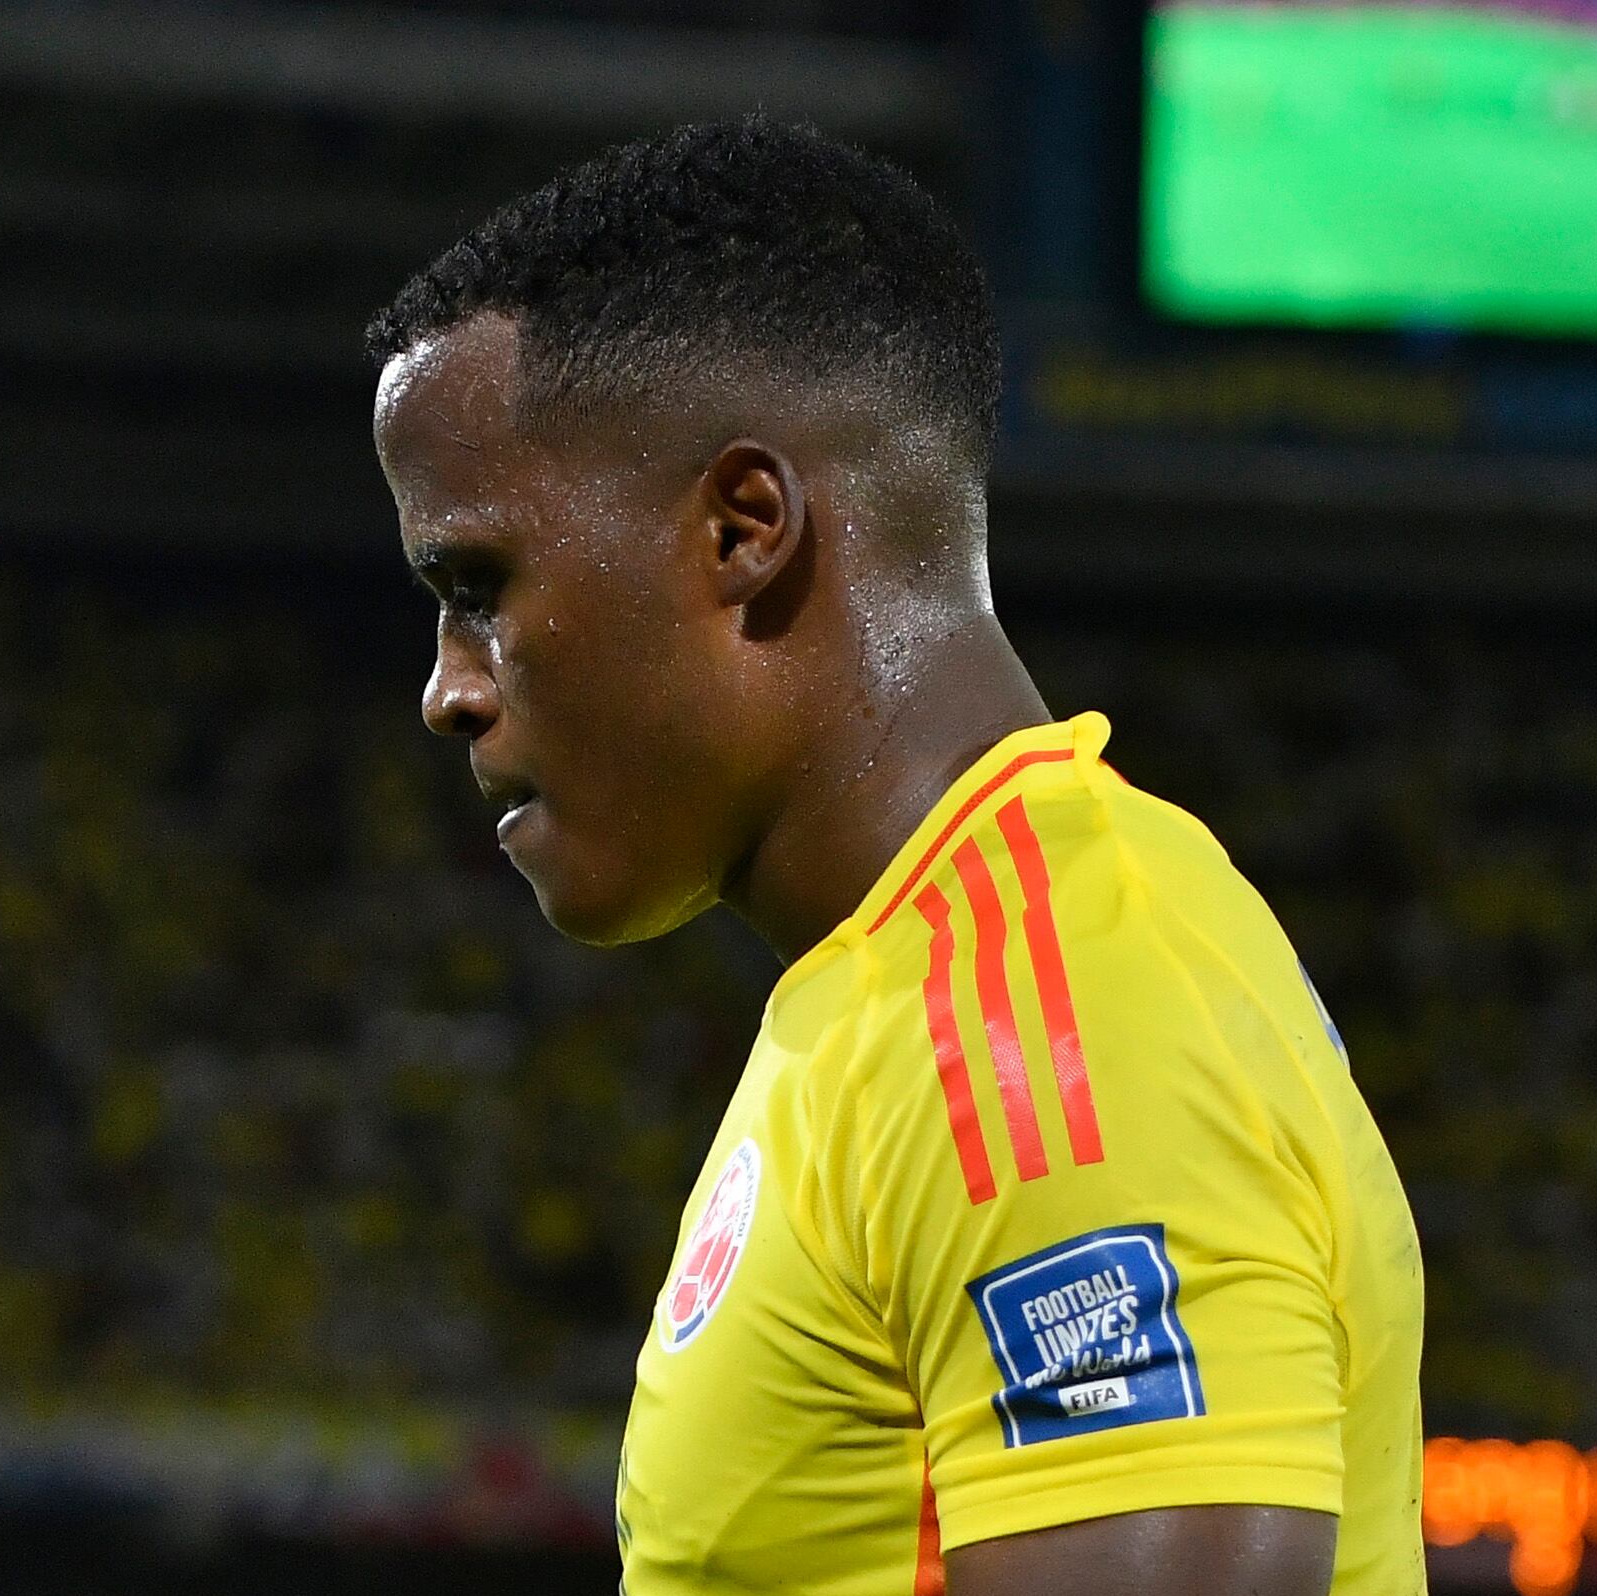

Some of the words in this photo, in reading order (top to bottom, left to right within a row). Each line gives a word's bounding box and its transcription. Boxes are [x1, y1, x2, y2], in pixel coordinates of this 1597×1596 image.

[1021, 1264, 1137, 1332] FOOTBALL
[1033, 1295, 1139, 1367] UNITES
[1070, 1334, 1152, 1378] World
[1070, 1386, 1119, 1411] FIFA
